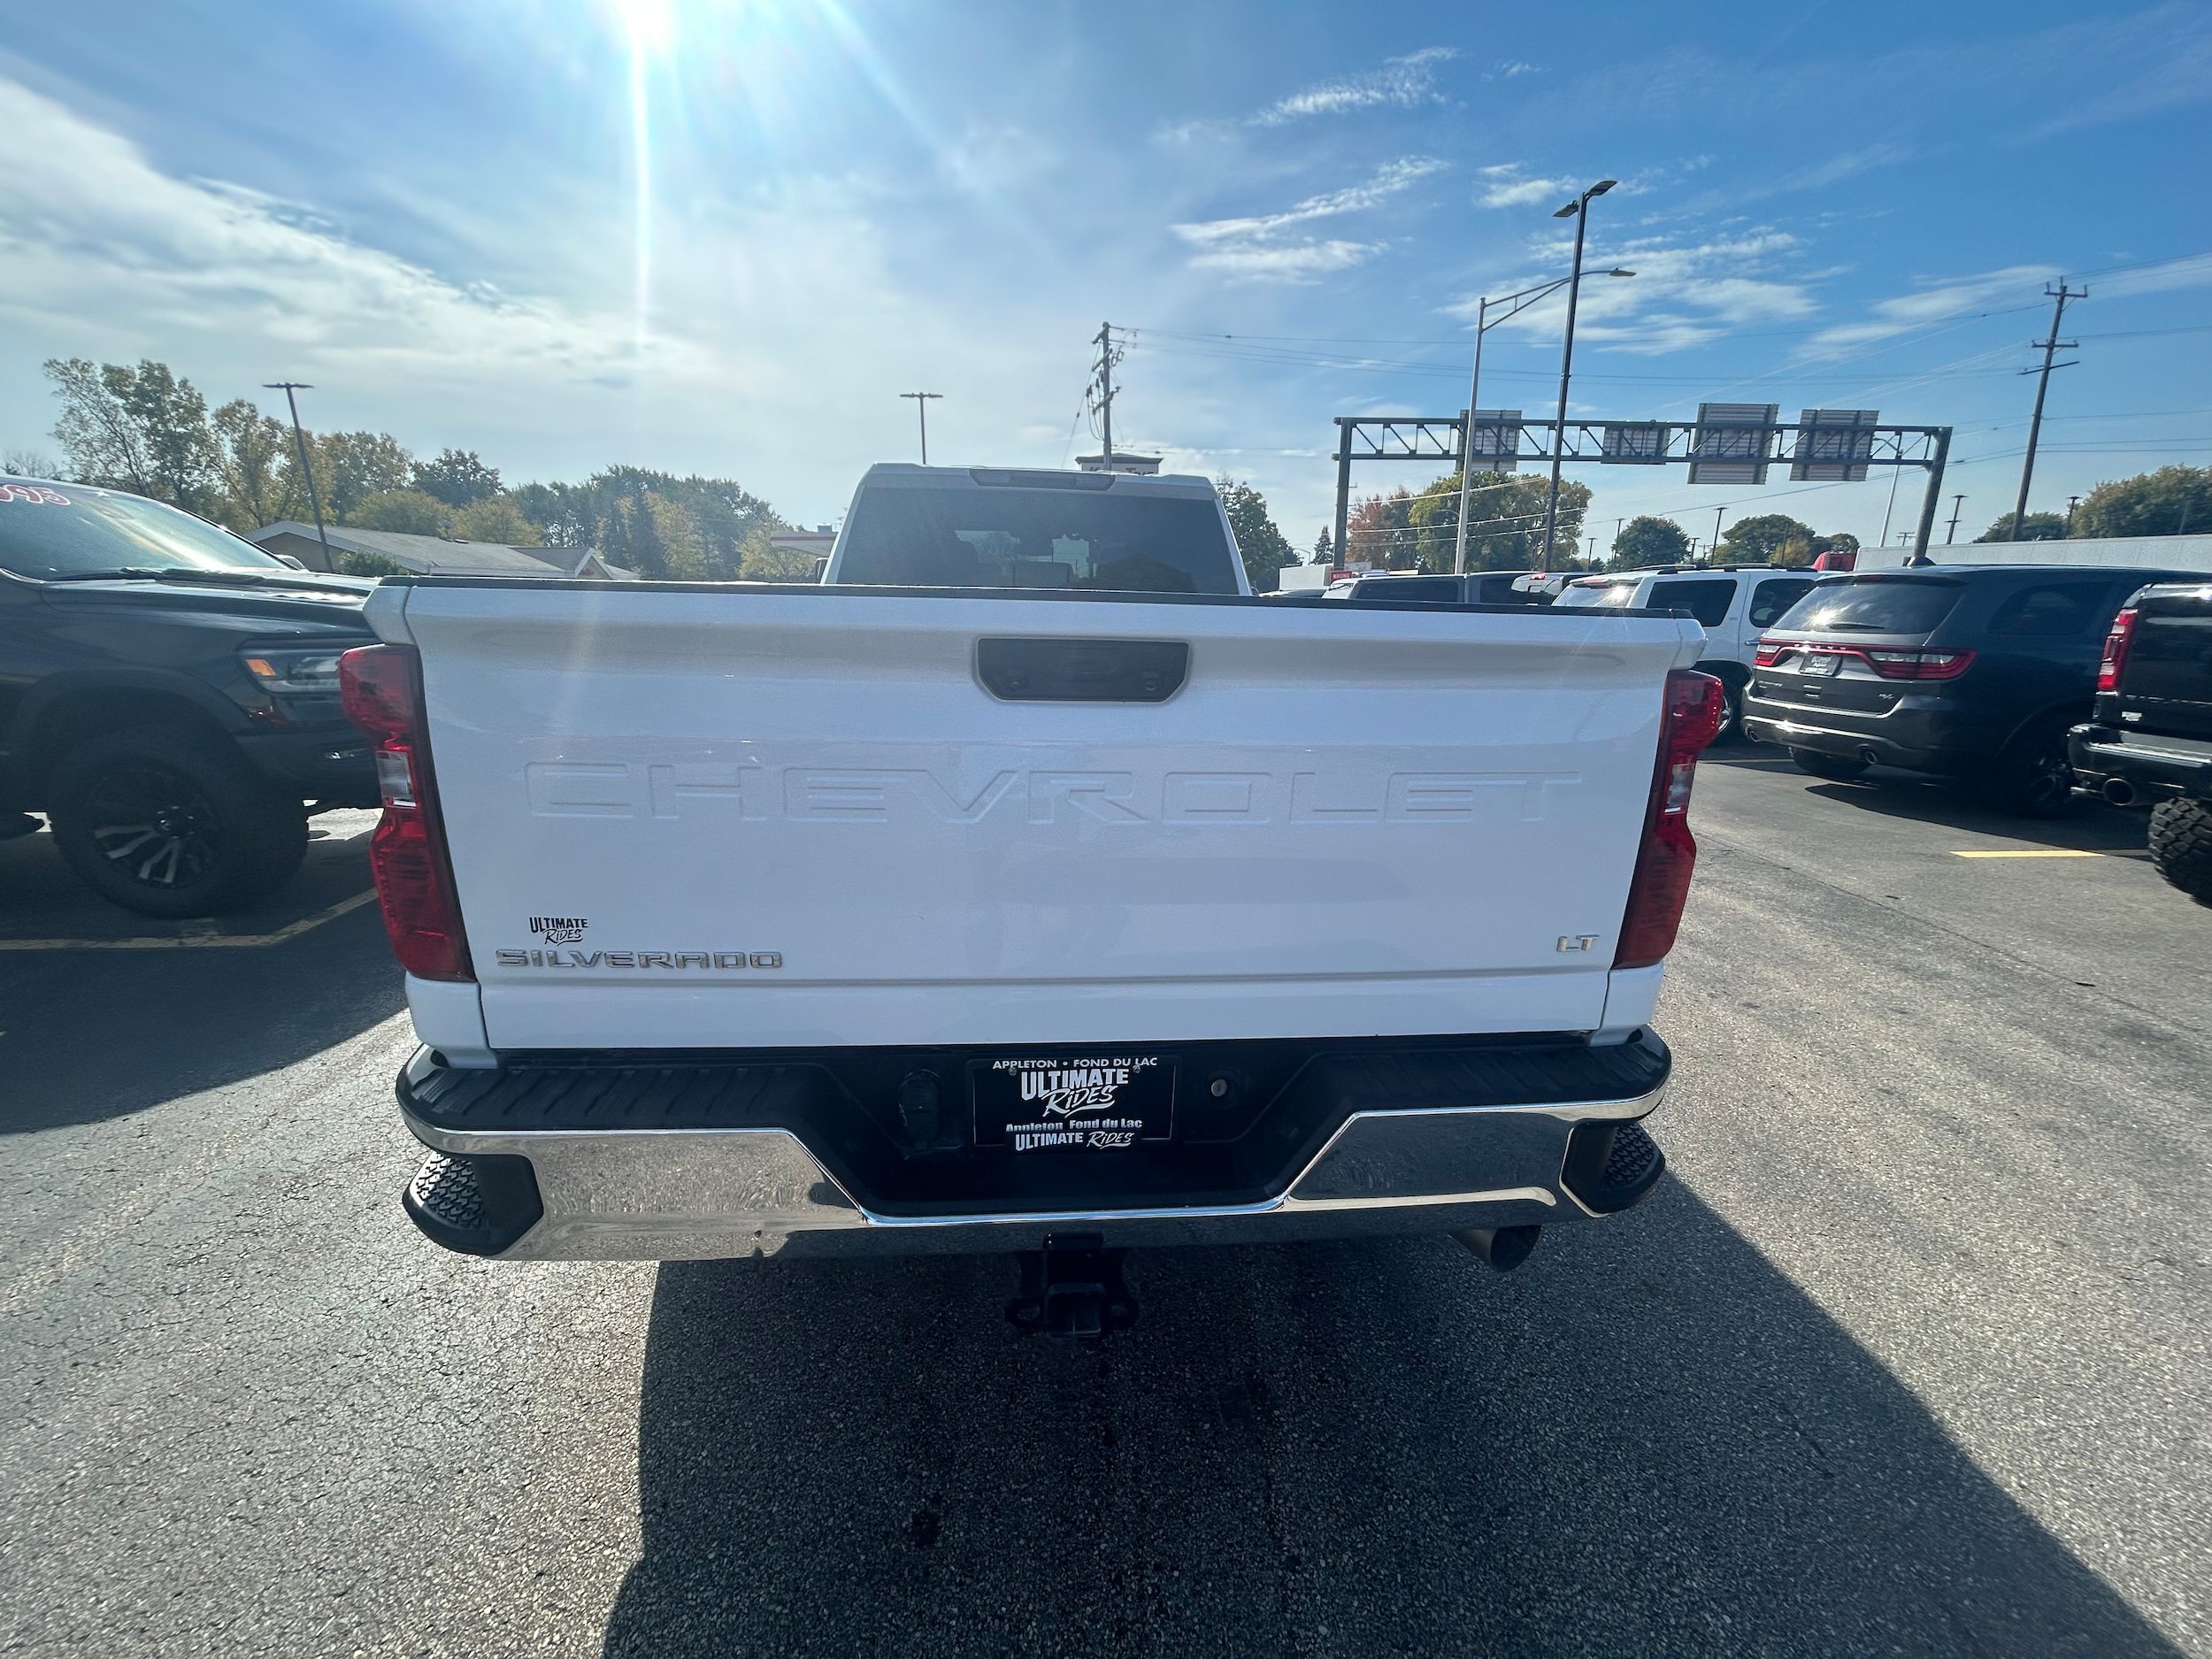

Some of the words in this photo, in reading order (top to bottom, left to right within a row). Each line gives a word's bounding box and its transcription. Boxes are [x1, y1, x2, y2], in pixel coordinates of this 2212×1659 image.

[0, 484, 71, 505] 95
[524, 761, 1582, 825] CHEVROLET
[529, 917, 588, 933] ULTIMATE
[1556, 934, 1600, 952] LT
[495, 949, 782, 969] SILVERADO
[992, 1059, 1057, 1070] APPLETON
[1073, 1058, 1110, 1069] FOND
[1113, 1057, 1132, 1067] DU
[1134, 1056, 1158, 1067] LAC
[1021, 1068, 1129, 1101] ULTIMATE
[1069, 1119, 1100, 1130] Fond
[1102, 1118, 1118, 1129] du
[1120, 1118, 1143, 1129] Lac
[1015, 1132, 1084, 1152] ULTIMATE
